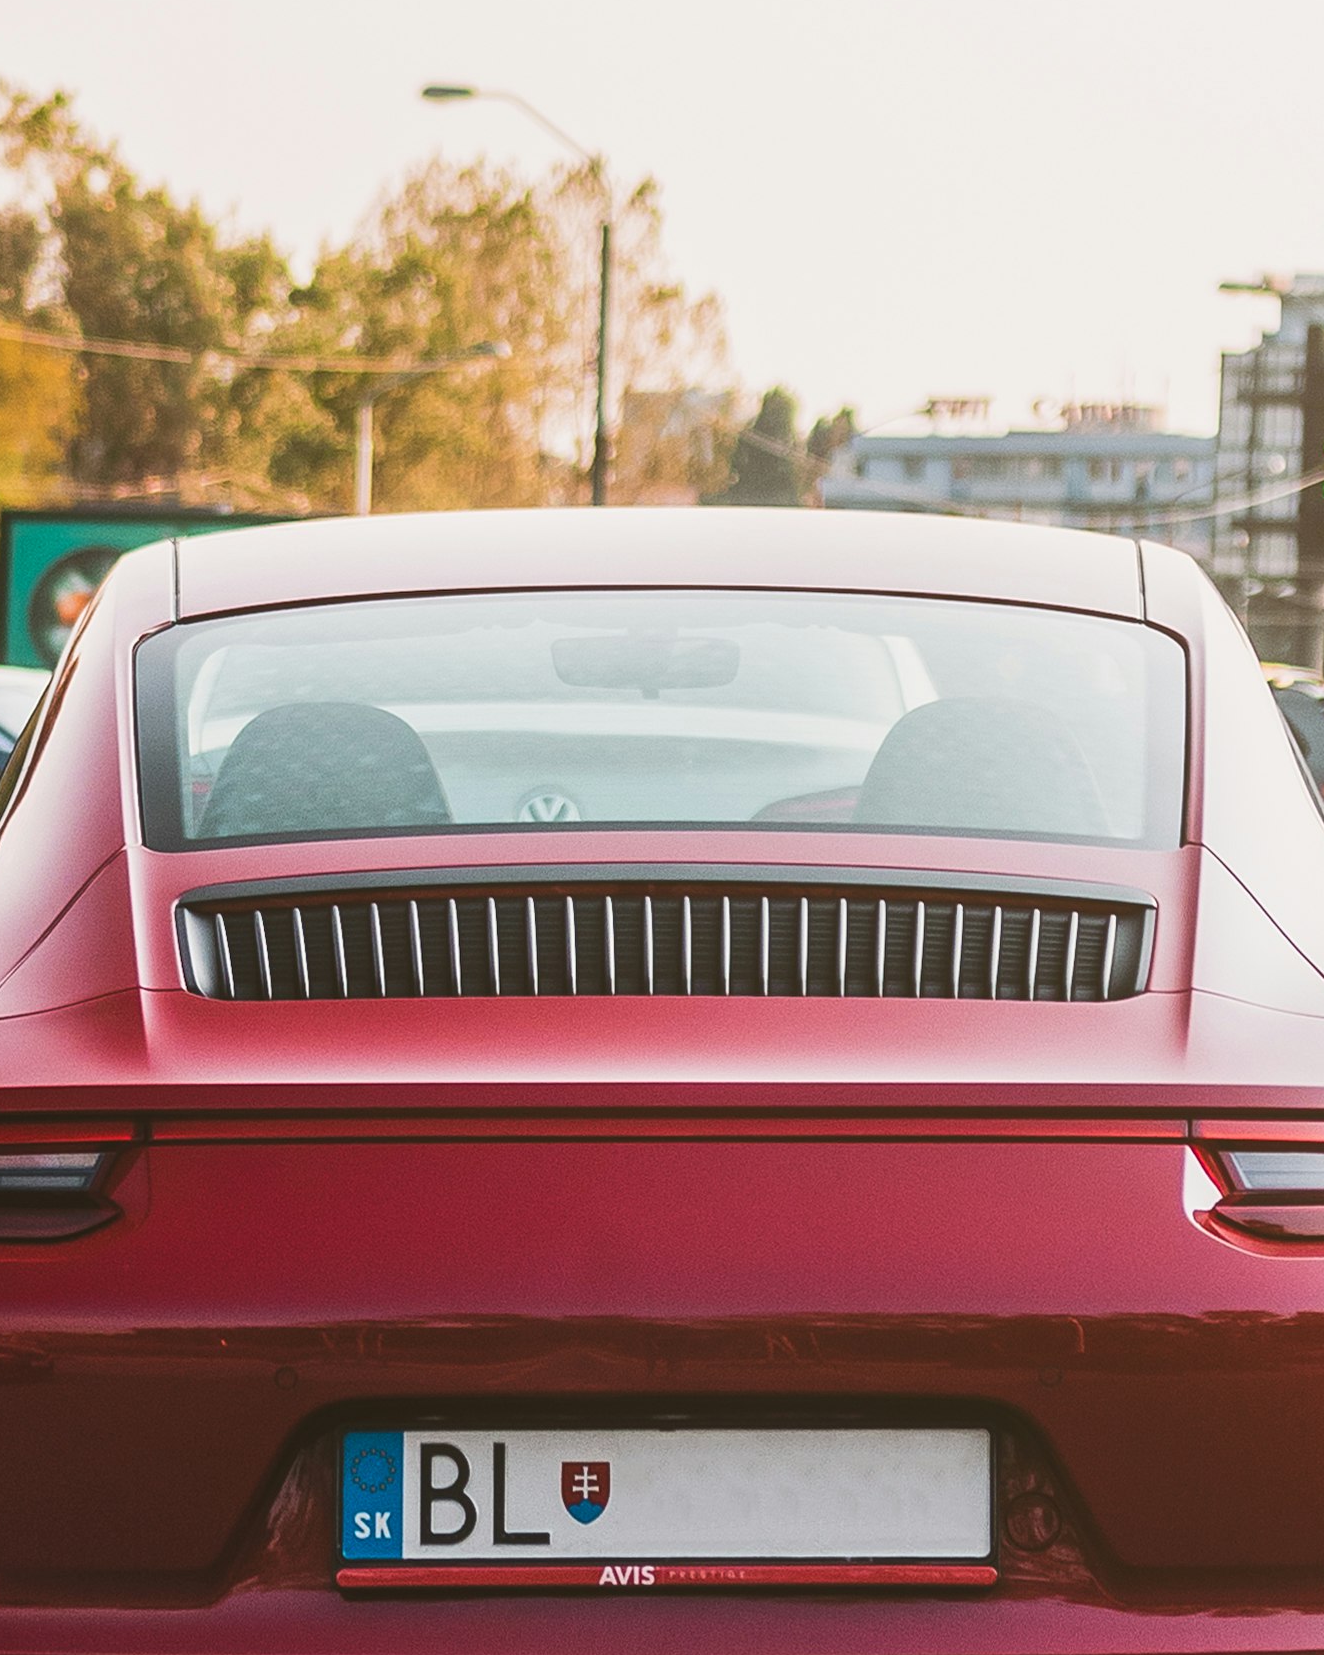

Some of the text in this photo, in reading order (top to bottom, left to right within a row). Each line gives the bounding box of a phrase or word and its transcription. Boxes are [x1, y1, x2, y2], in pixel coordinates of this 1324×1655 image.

[420, 1442, 550, 1545] BL
[354, 1511, 391, 1539] SK
[599, 1566, 655, 1585] AVIS
